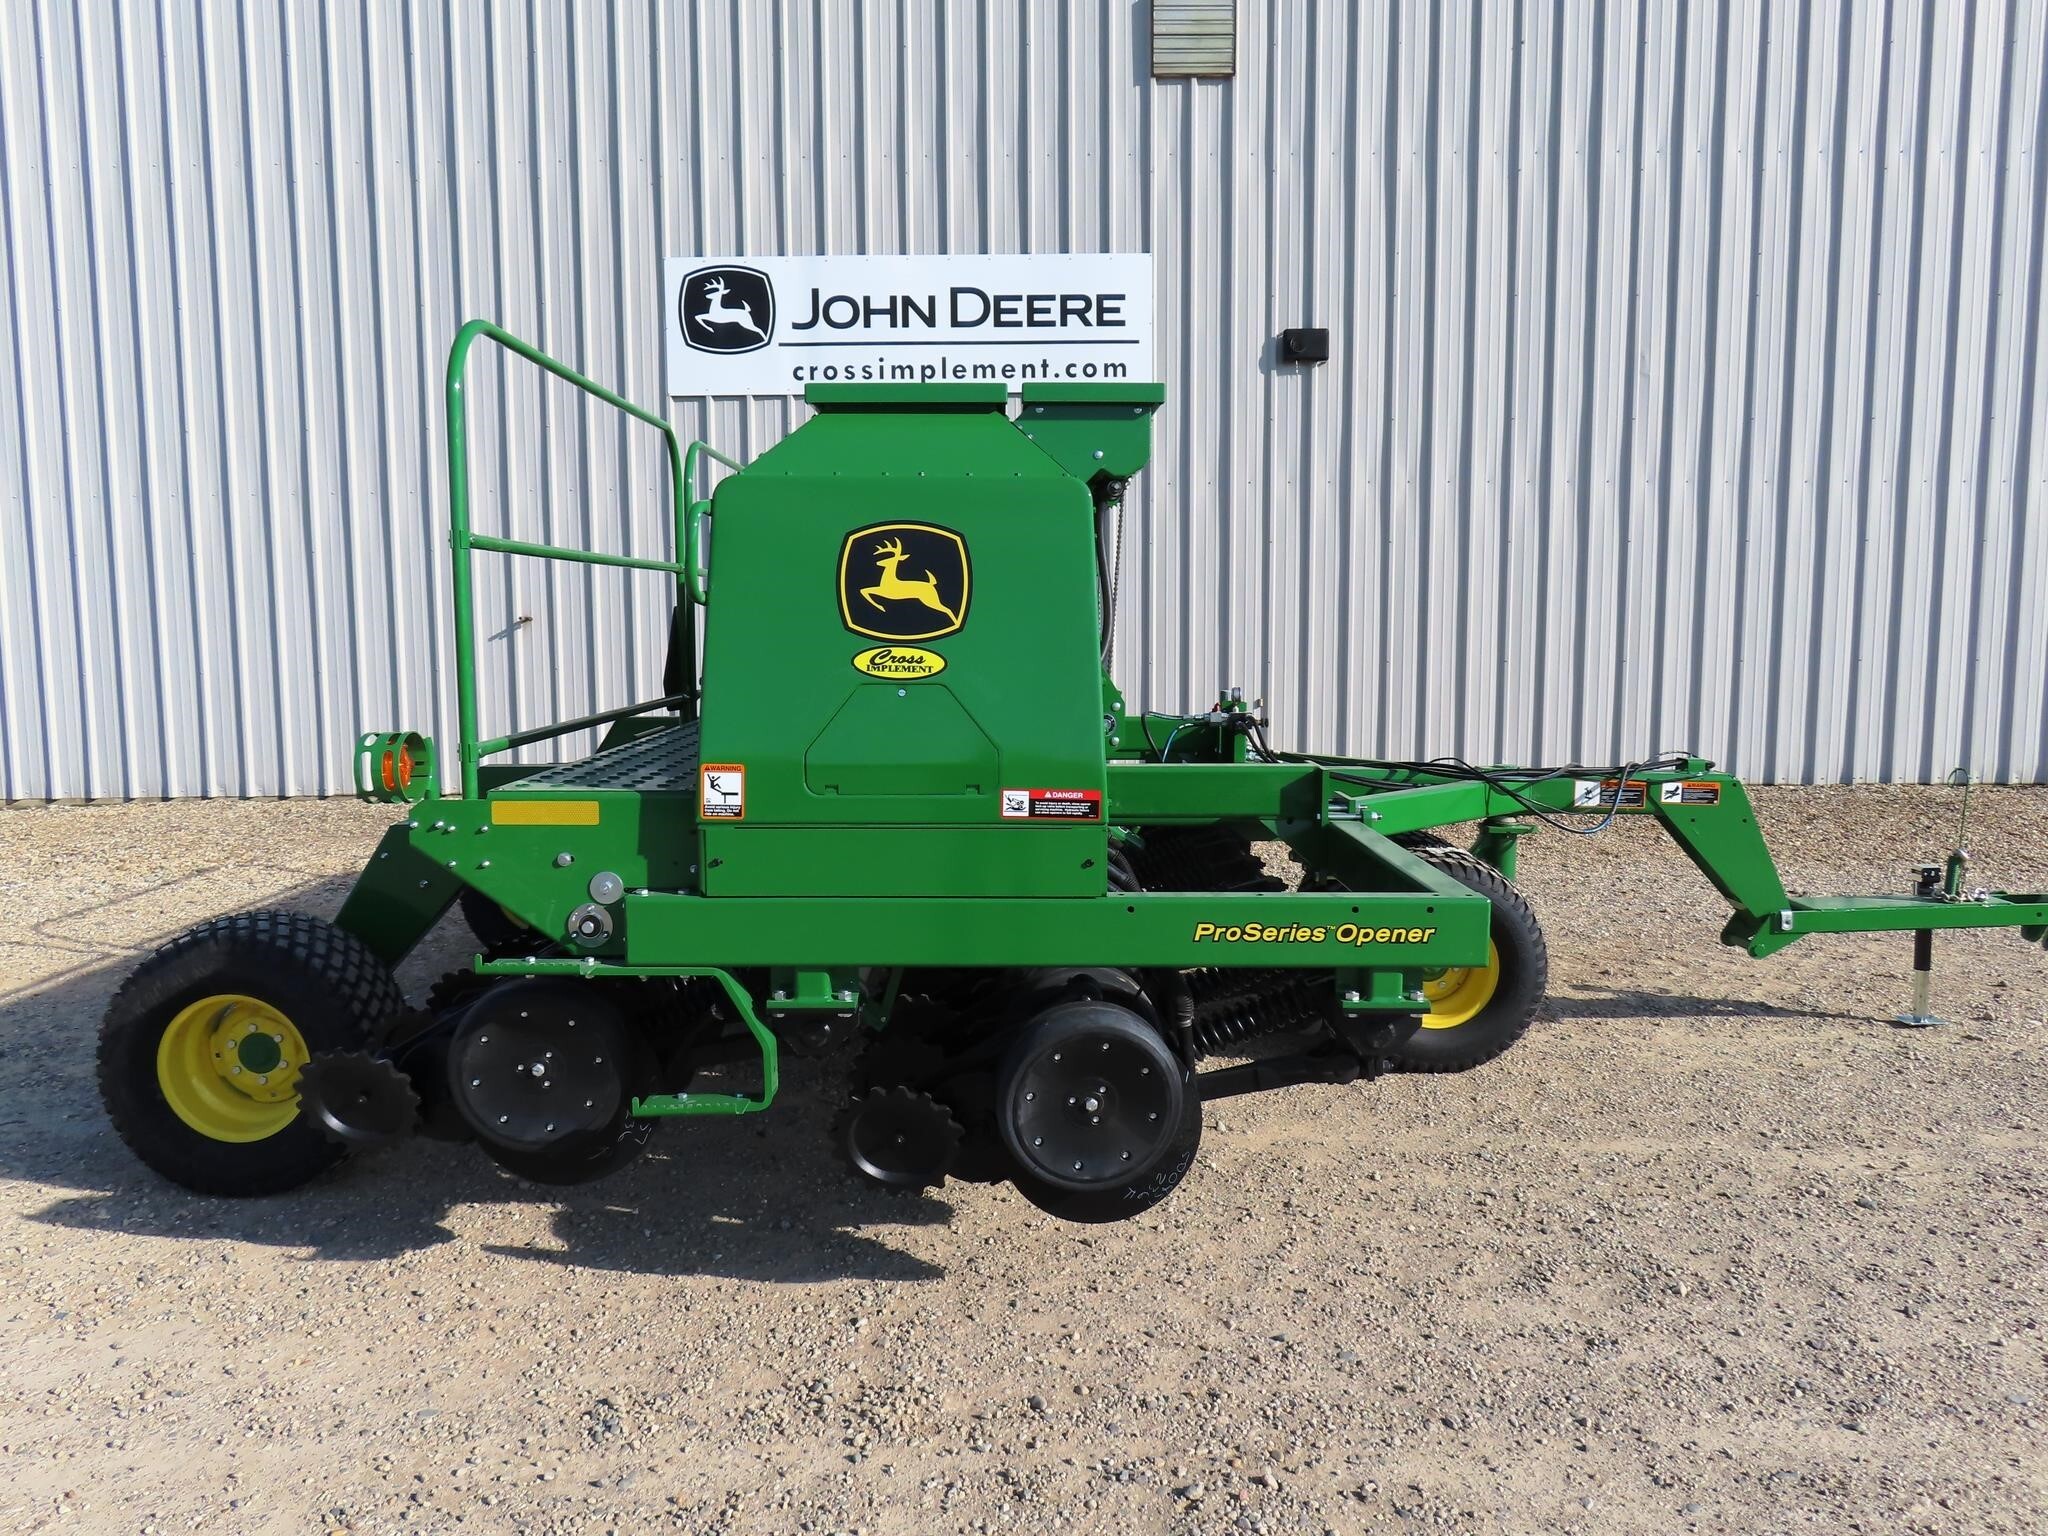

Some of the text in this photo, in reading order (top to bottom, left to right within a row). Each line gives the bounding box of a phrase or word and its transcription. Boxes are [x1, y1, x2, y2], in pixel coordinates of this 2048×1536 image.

[791, 286, 1127, 330] JOHN DEERE
[792, 356, 1128, 383] crossimplement.com
[866, 664, 933, 673] IMPLEMENT
[869, 649, 926, 665] Cross
[1335, 922, 1436, 946] Opener
